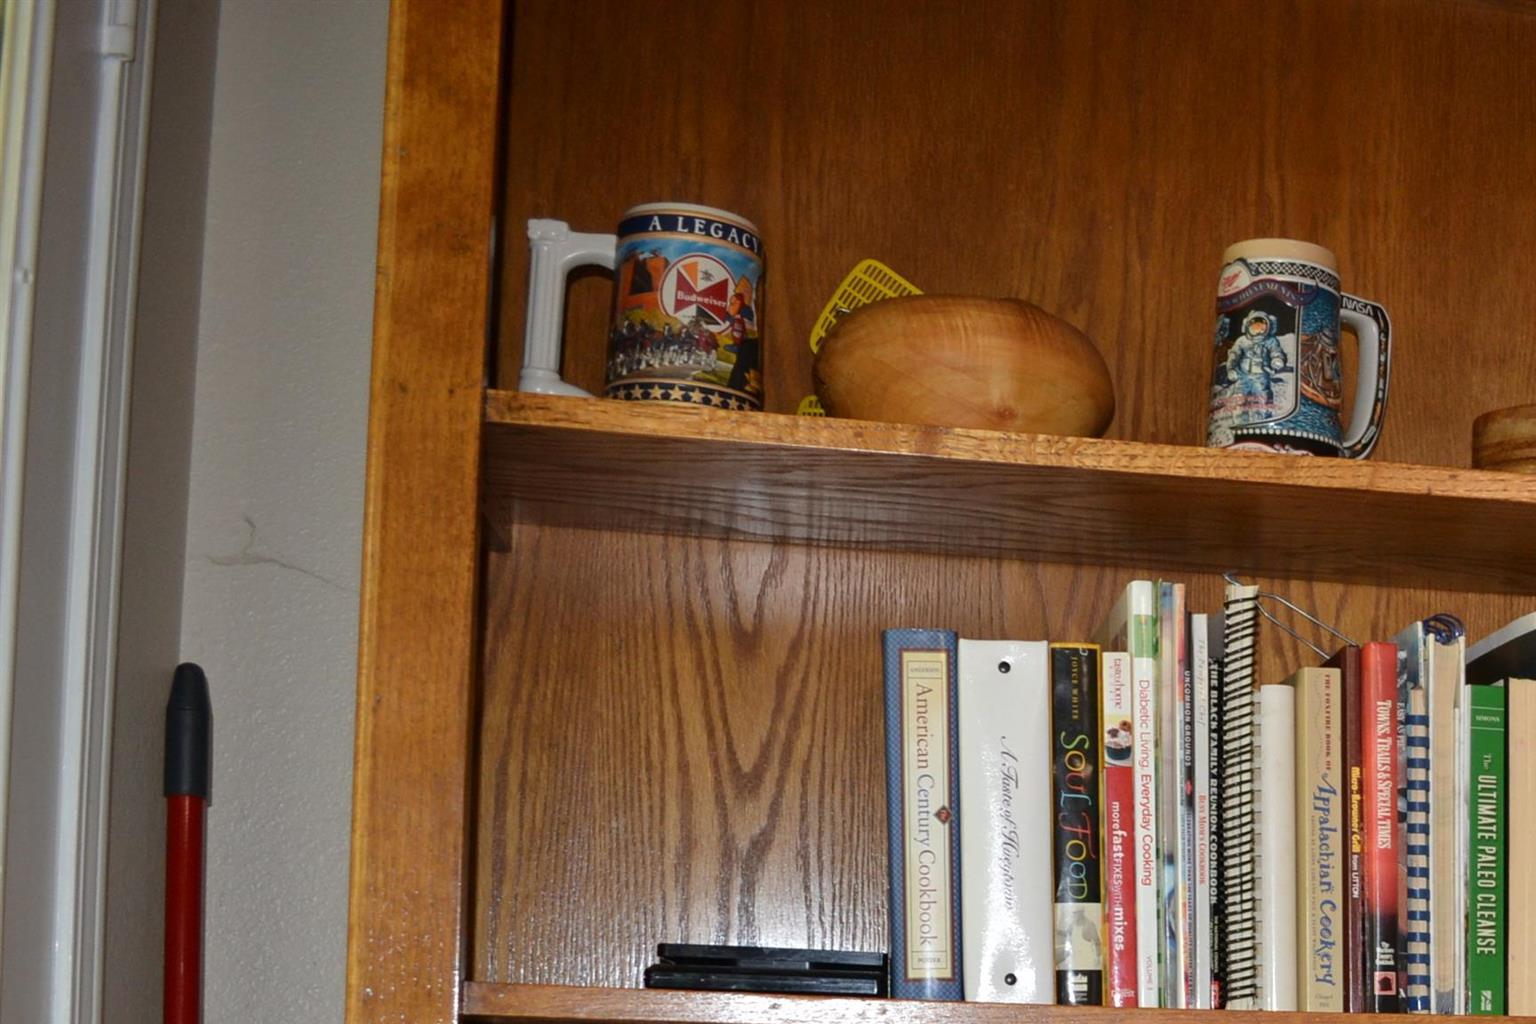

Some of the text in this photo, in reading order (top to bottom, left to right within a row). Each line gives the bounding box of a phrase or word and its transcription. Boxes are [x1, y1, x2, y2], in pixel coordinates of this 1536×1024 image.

[649, 215, 758, 254] A LEGACY
[676, 289, 728, 308] Budweiser
[1342, 297, 1374, 316] NASA
[915, 682, 934, 769] American
[1184, 670, 1193, 767] UNCOMMON GROUNDS
[1209, 690, 1219, 729] BLACK
[1138, 679, 1155, 886] Diabetic Everyday Cooking
[1209, 732, 1219, 775] FAMILY
[1376, 737, 1392, 772] TRAILS
[913, 773, 936, 848] Century
[1000, 764, 1019, 827] Taste of
[1059, 731, 1096, 900] SOUL FOOD
[1209, 778, 1219, 832] REUNION
[1376, 780, 1392, 818] SPECIAL
[1377, 819, 1392, 849] TIMES
[1476, 774, 1498, 954] ULTIMATE PALEO CLEANSE
[1209, 835, 1219, 905] COOKBOOK
[1313, 772, 1339, 986] Appalachian Cookery
[1350, 834, 1361, 898] Grill LITTON
[916, 850, 940, 946] Cookbook
[1113, 906, 1127, 951] mixes
